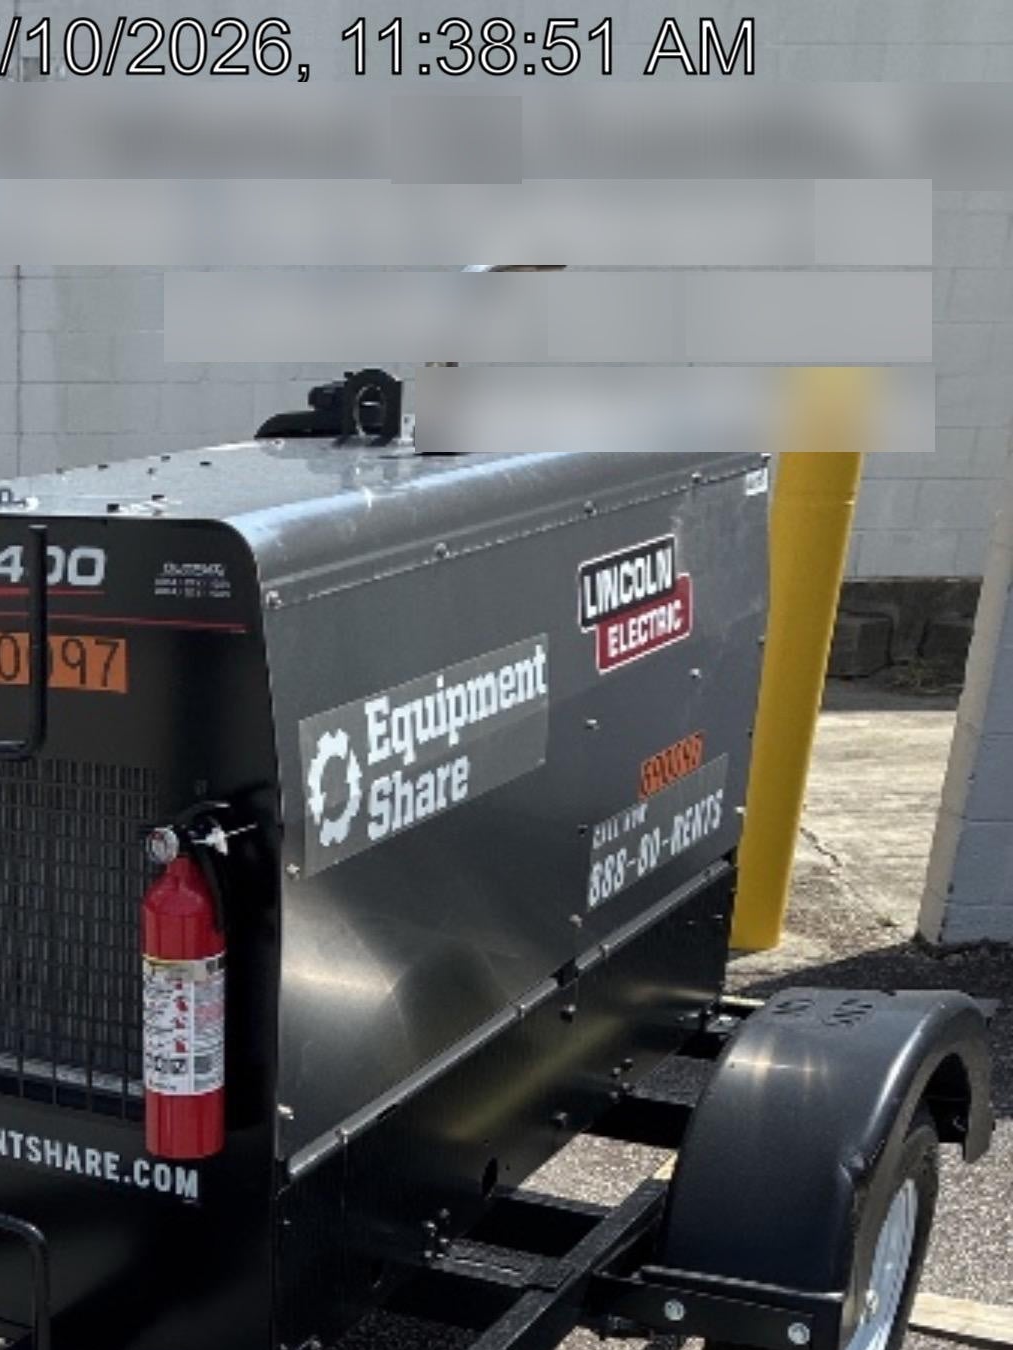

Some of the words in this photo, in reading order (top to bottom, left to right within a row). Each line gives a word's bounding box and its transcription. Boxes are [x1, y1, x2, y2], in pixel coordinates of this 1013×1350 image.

[584, 546, 672, 619] LINCOLN
[607, 600, 682, 658] ELECTRIC
[364, 644, 547, 766] Equipment
[368, 755, 471, 841] Share
